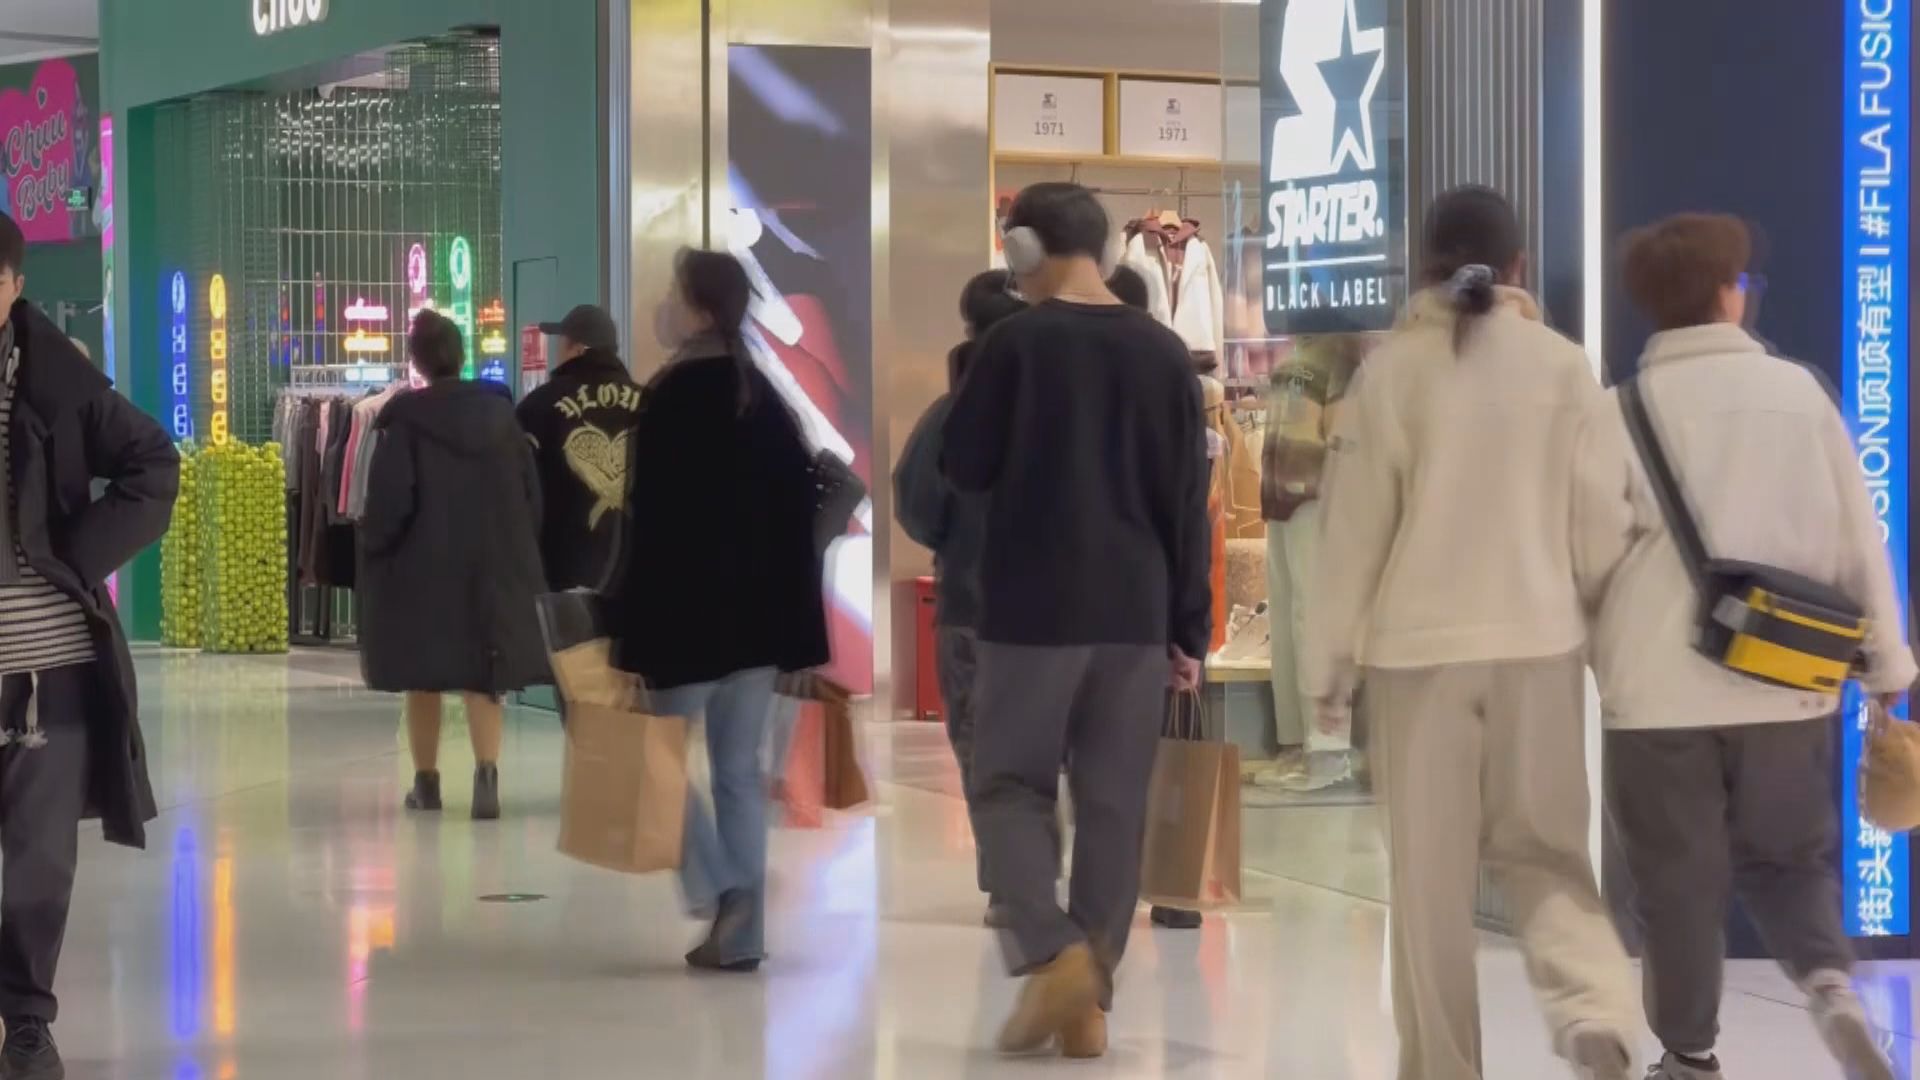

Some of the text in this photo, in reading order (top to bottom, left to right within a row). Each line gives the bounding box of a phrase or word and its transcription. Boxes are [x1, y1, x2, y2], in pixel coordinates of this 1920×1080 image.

[5, 110, 66, 177] Chuu
[1034, 121, 1064, 136] 1971
[1159, 127, 1188, 141] 1971
[16, 158, 69, 221] Baby
[1859, 123, 1892, 240] #FILA
[1266, 277, 1387, 312] BLACK LABEL
